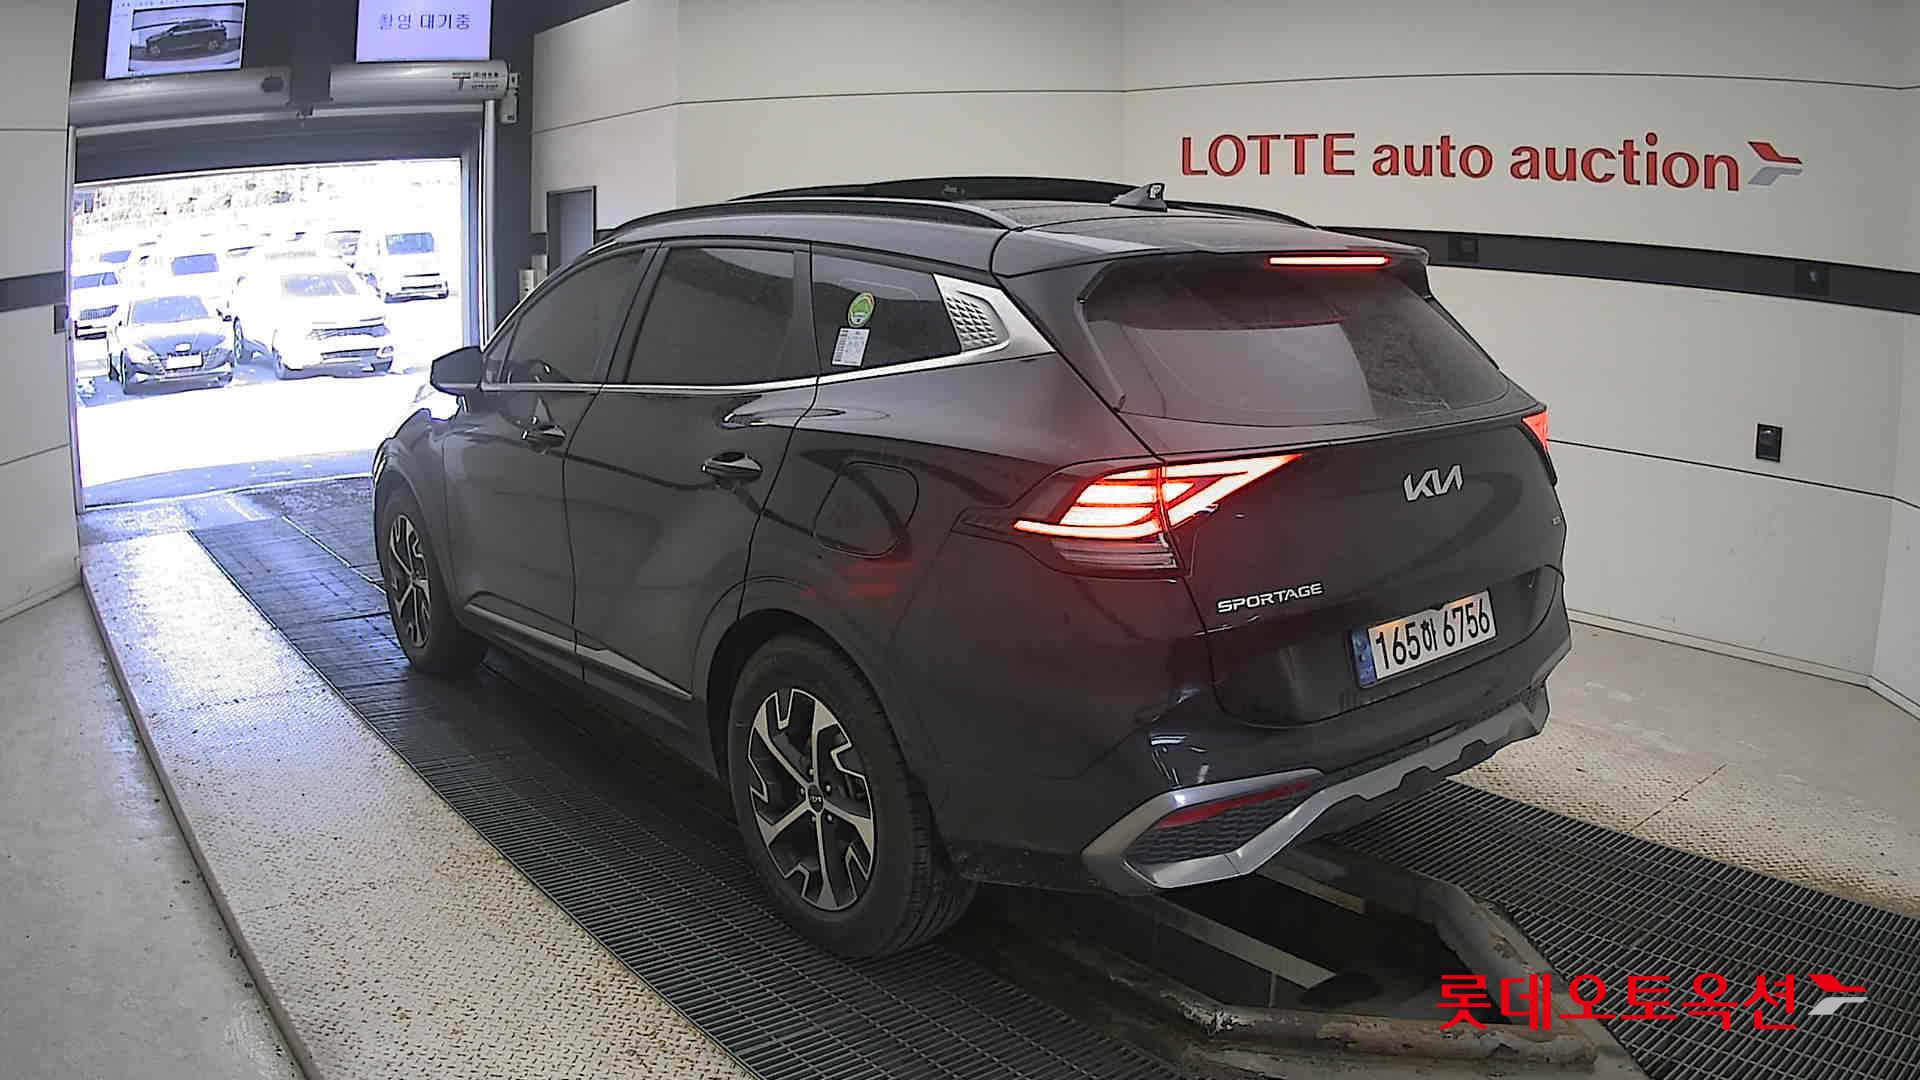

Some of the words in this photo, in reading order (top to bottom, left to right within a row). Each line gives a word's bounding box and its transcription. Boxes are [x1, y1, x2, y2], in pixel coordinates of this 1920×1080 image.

[420, 13, 472, 30] 대기중
[1181, 132, 1356, 177] LOTTE
[1371, 135, 1494, 179] auto
[1509, 132, 1740, 192] auction
[1402, 464, 1464, 503] KIA
[1217, 582, 1325, 614] SPORTAGE
[1375, 617, 1439, 670] 165하
[1443, 598, 1491, 647] 6756
